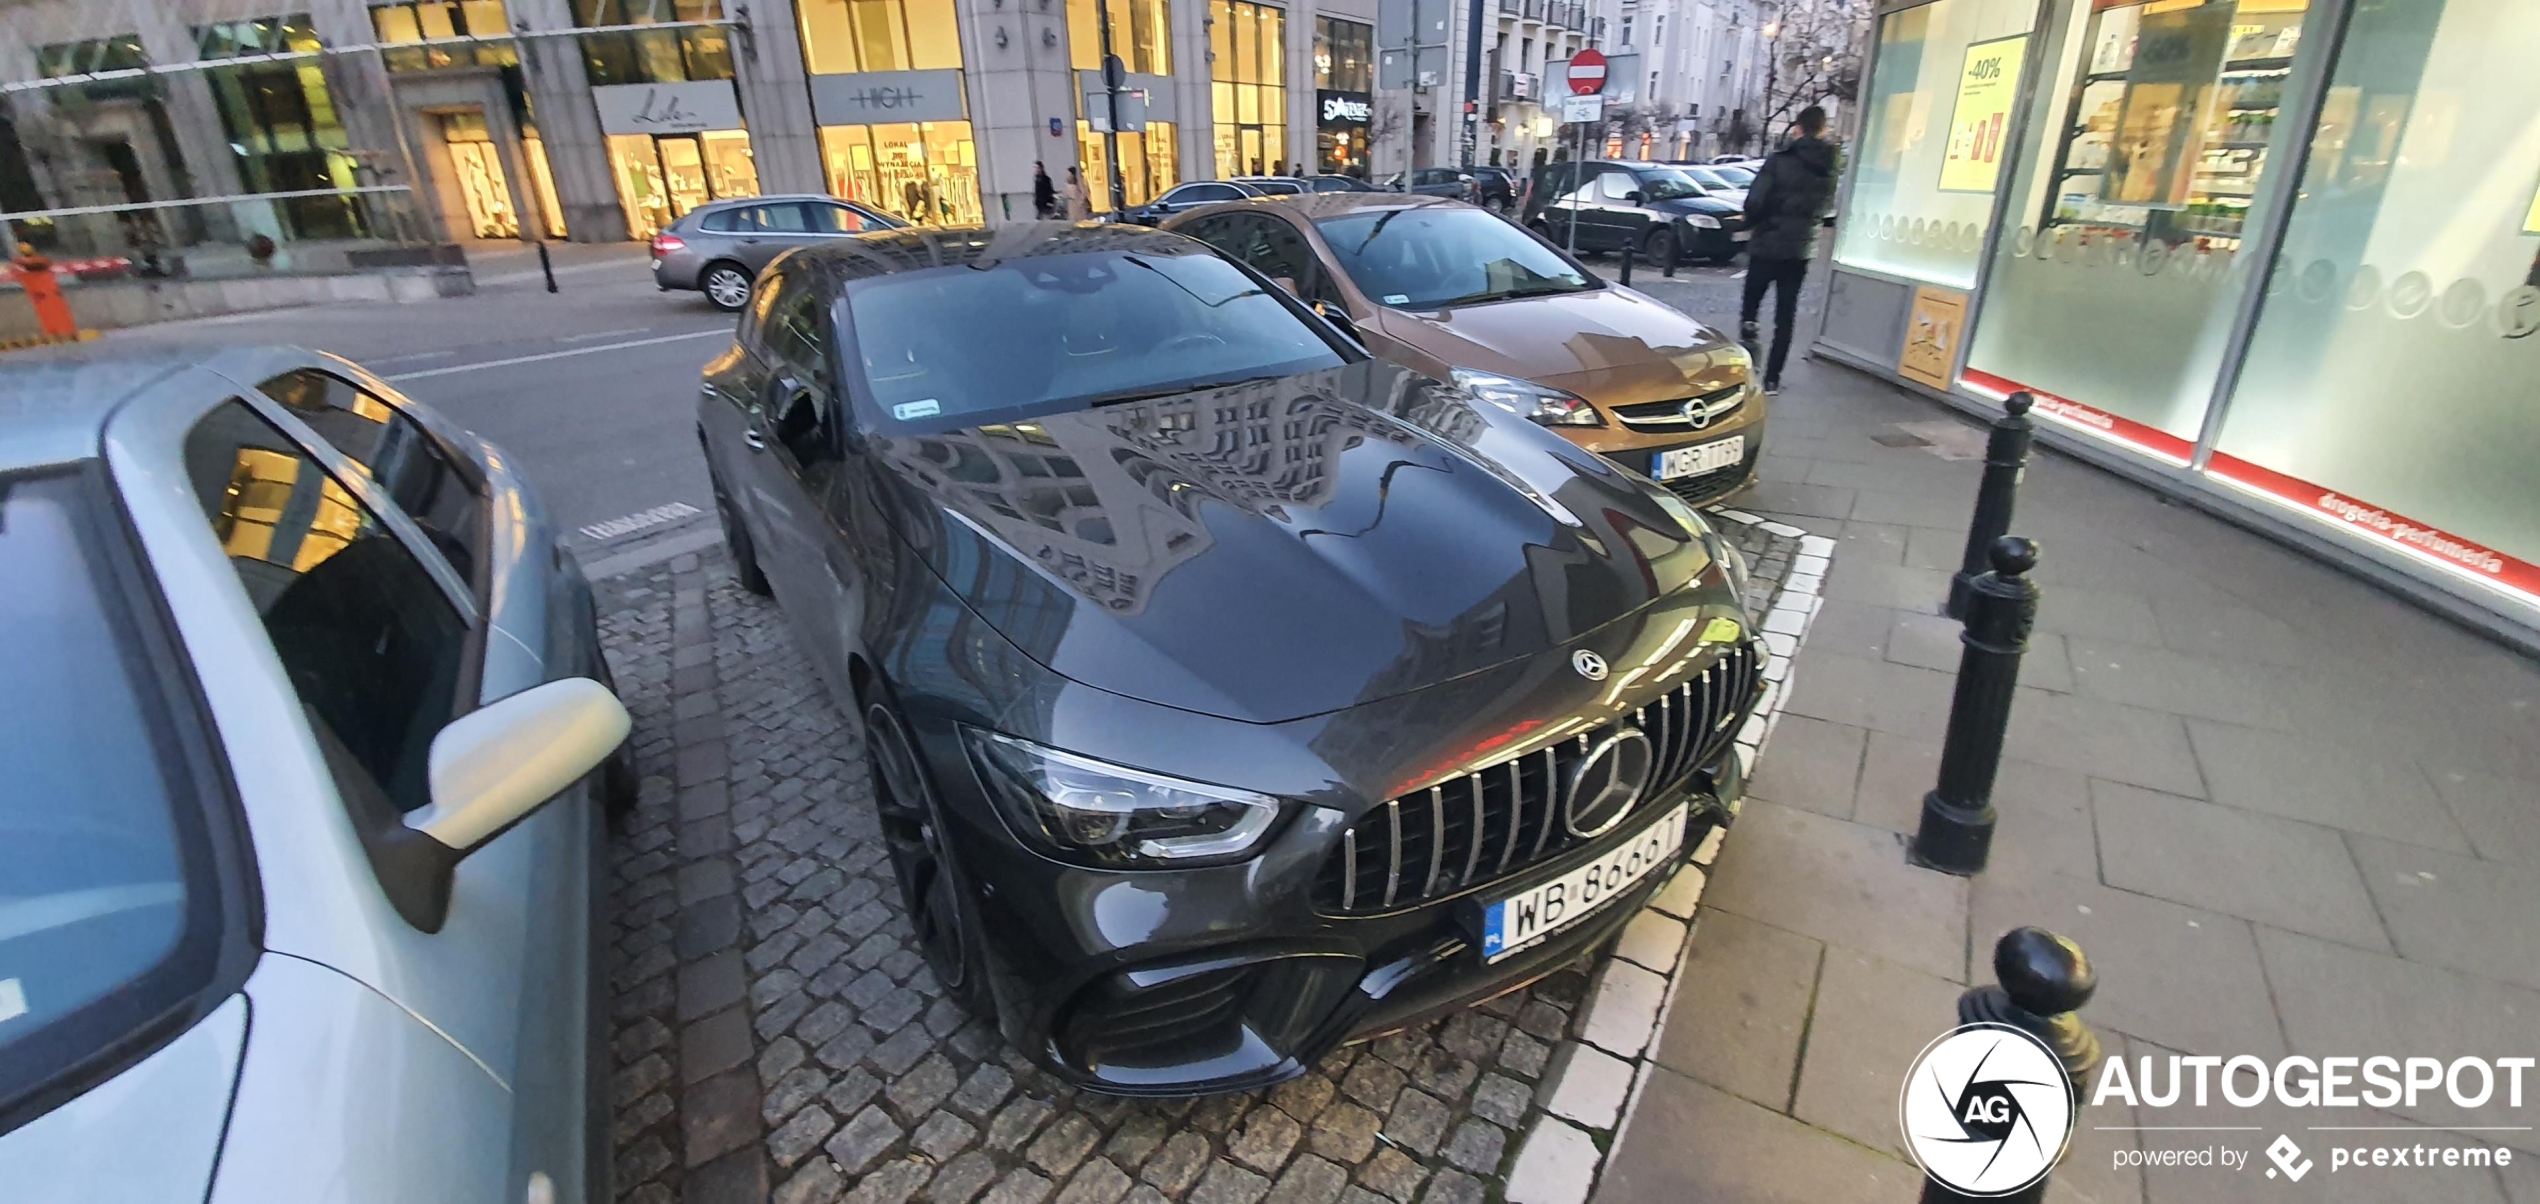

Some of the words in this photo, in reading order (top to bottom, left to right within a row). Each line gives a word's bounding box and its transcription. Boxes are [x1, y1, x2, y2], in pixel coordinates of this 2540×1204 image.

[1968, 56, 2002, 80] -40%
[849, 86, 923, 109] HIGH
[884, 141, 908, 149] LOKAL
[2318, 493, 2503, 574] drogeria-perfumeria
[1516, 882, 1566, 938] WB
[1582, 810, 1682, 904] 8666T
